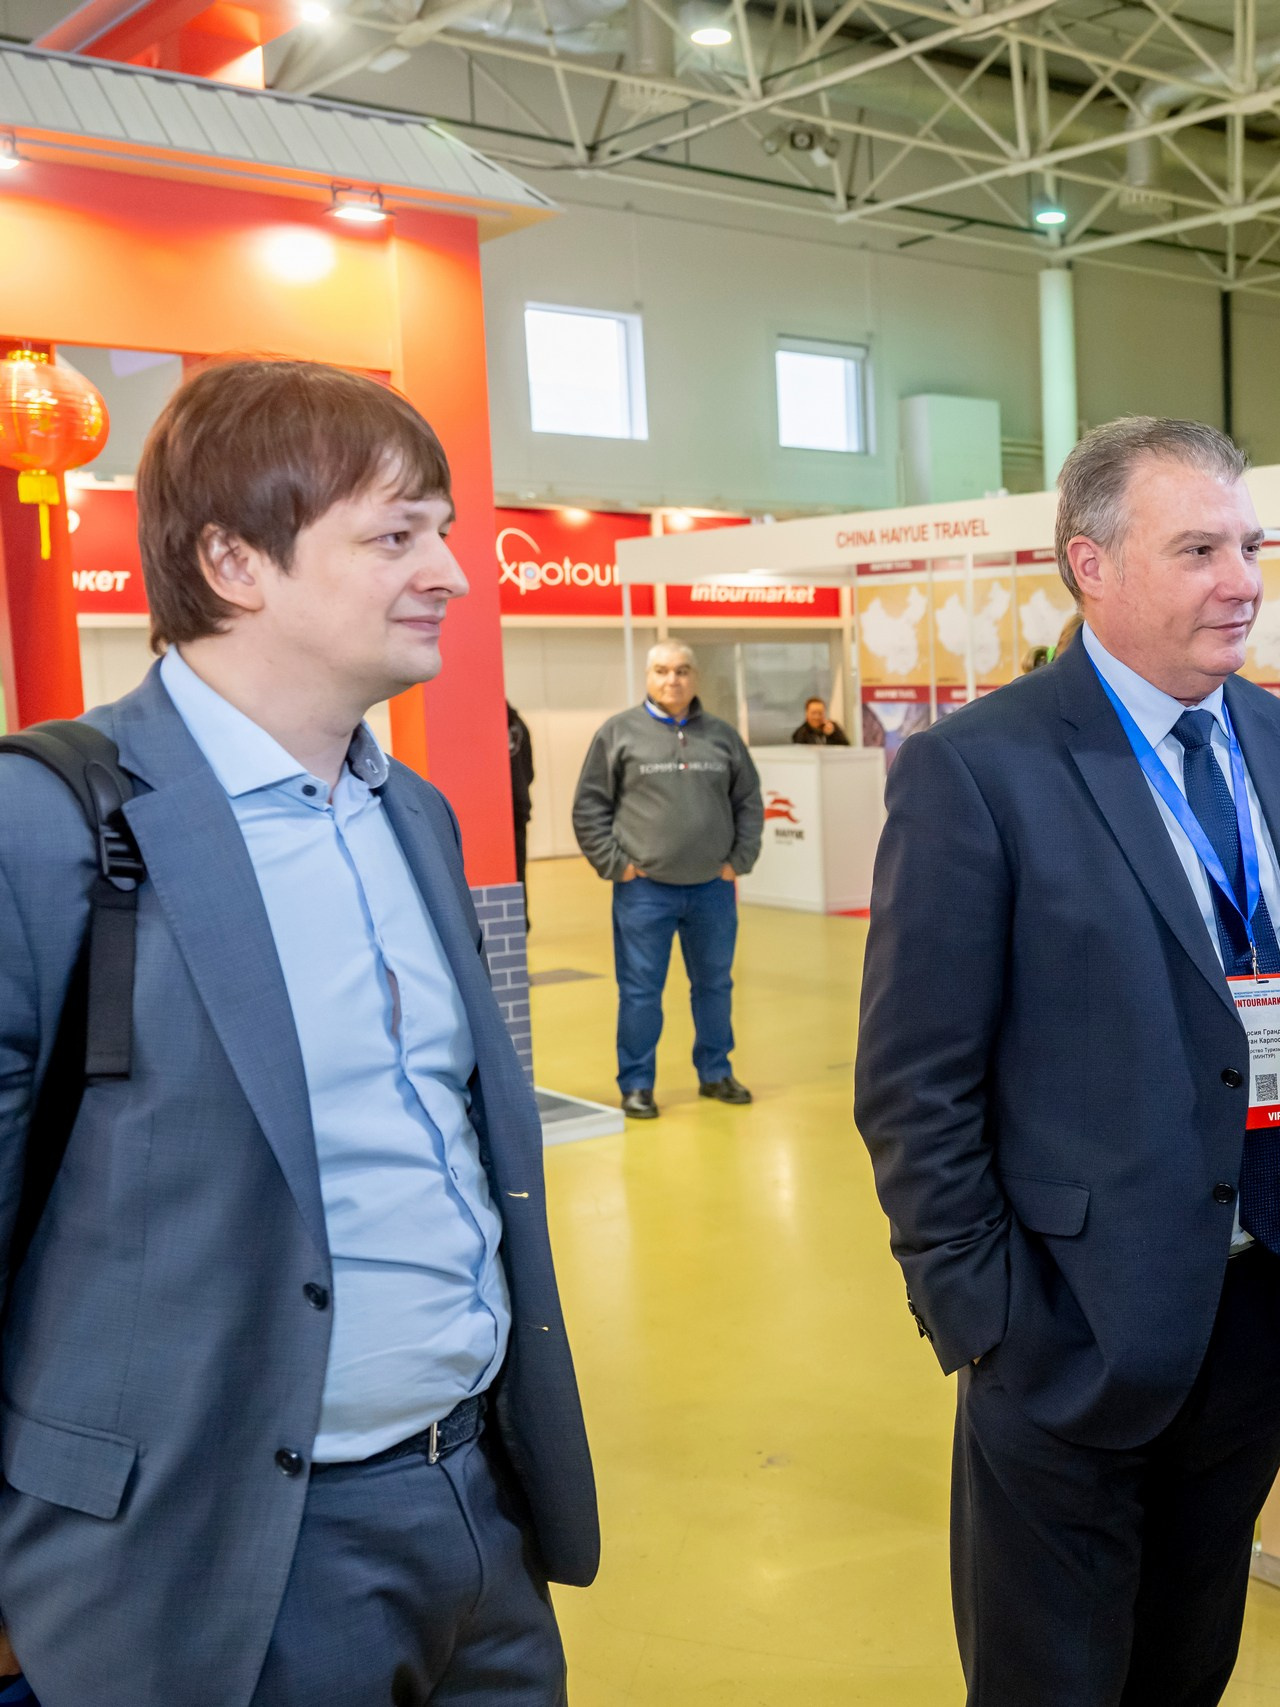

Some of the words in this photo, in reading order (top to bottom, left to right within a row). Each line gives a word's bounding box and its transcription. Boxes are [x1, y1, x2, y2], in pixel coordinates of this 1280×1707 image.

[836, 530, 877, 548] CHINA
[880, 523, 930, 544] HAIYUE
[933, 518, 990, 539] TRAVEL
[690, 583, 816, 604] intourmarket
